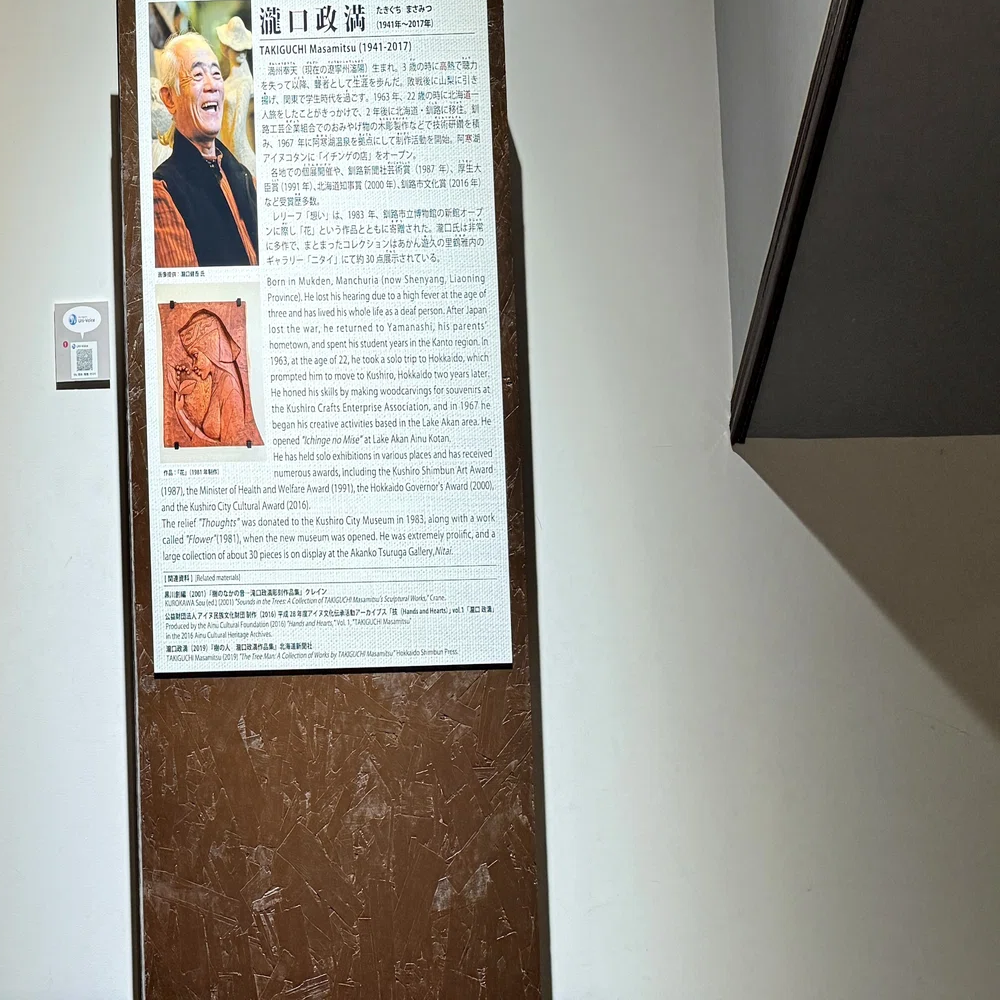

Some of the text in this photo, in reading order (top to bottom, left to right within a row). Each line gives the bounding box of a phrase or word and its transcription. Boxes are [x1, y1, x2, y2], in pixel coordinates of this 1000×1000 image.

[406, 5, 433, 14] まさみつ
[259, 41, 412, 56] TAKIGUCHI Masamitsu (1941-2017)
[267, 277, 286, 287] Born
[288, 277, 296, 286] in
[336, 275, 379, 285] Manchuria
[381, 275, 402, 286] (now
[449, 274, 486, 286] Liaoning
[304, 292, 314, 301] He
[316, 291, 329, 301] lost
[331, 291, 341, 300] his
[343, 290, 370, 302] hearing
[372, 290, 386, 300] due
[388, 291, 395, 299] to
[403, 289, 419, 301] high
[421, 289, 439, 298] fever
[441, 290, 448, 298] at
[450, 288, 462, 298] the
[464, 290, 477, 300] age
[479, 288, 487, 297] of
[269, 324, 284, 334] lost
[287, 324, 300, 333] the
[324, 323, 334, 332] he
[336, 322, 373, 332] returned
[376, 323, 385, 331] to
[438, 320, 450, 330] his
[312, 339, 325, 349] and
[327, 340, 347, 351] spent
[348, 338, 359, 348] his
[360, 338, 388, 348] student
[390, 340, 408, 349] years
[410, 338, 417, 347] in
[418, 337, 430, 347] the
[432, 337, 453, 346] Kanto
[481, 336, 489, 345] In
[270, 372, 307, 384] prompted
[309, 372, 323, 381] him
[325, 373, 332, 381] to
[334, 373, 355, 381] move
[357, 372, 365, 380] to
[397, 369, 432, 379] Hokkaido
[434, 370, 448, 378] two
[450, 371, 469, 380] years
[271, 404, 284, 413] the
[287, 403, 316, 413] Kushiro
[318, 402, 340, 412] Crafts
[342, 402, 382, 414] Enterprise
[433, 401, 448, 410] and
[450, 401, 458, 410] in
[461, 401, 479, 410] 1967
[481, 400, 491, 410] he
[272, 436, 300, 448] opened
[364, 436, 371, 444] at
[373, 434, 389, 444] Lake
[391, 434, 409, 444] Akan
[410, 434, 427, 443] Ainu
[274, 470, 311, 478] numerous
[342, 466, 377, 478] including
[378, 466, 391, 475] the
[392, 465, 420, 475] Kushiro
[422, 464, 455, 475] Shimbun
[457, 465, 468, 474] Art
[470, 464, 493, 474] Award
[161, 503, 175, 512] and
[176, 502, 188, 512] the
[190, 502, 216, 512] Kushiro
[218, 502, 231, 513] City
[233, 501, 260, 511] Cultural
[262, 500, 285, 510] Award
[162, 519, 175, 529] The
[178, 518, 196, 528] relief
[258, 516, 290, 527] donated
[291, 518, 299, 526] to
[301, 516, 314, 526] the
[316, 515, 344, 525] Kushiro
[346, 516, 360, 527] City
[362, 515, 395, 524] Museum
[397, 515, 404, 524] in
[428, 513, 450, 525] along
[452, 512, 468, 522] with
[476, 512, 495, 522] work
